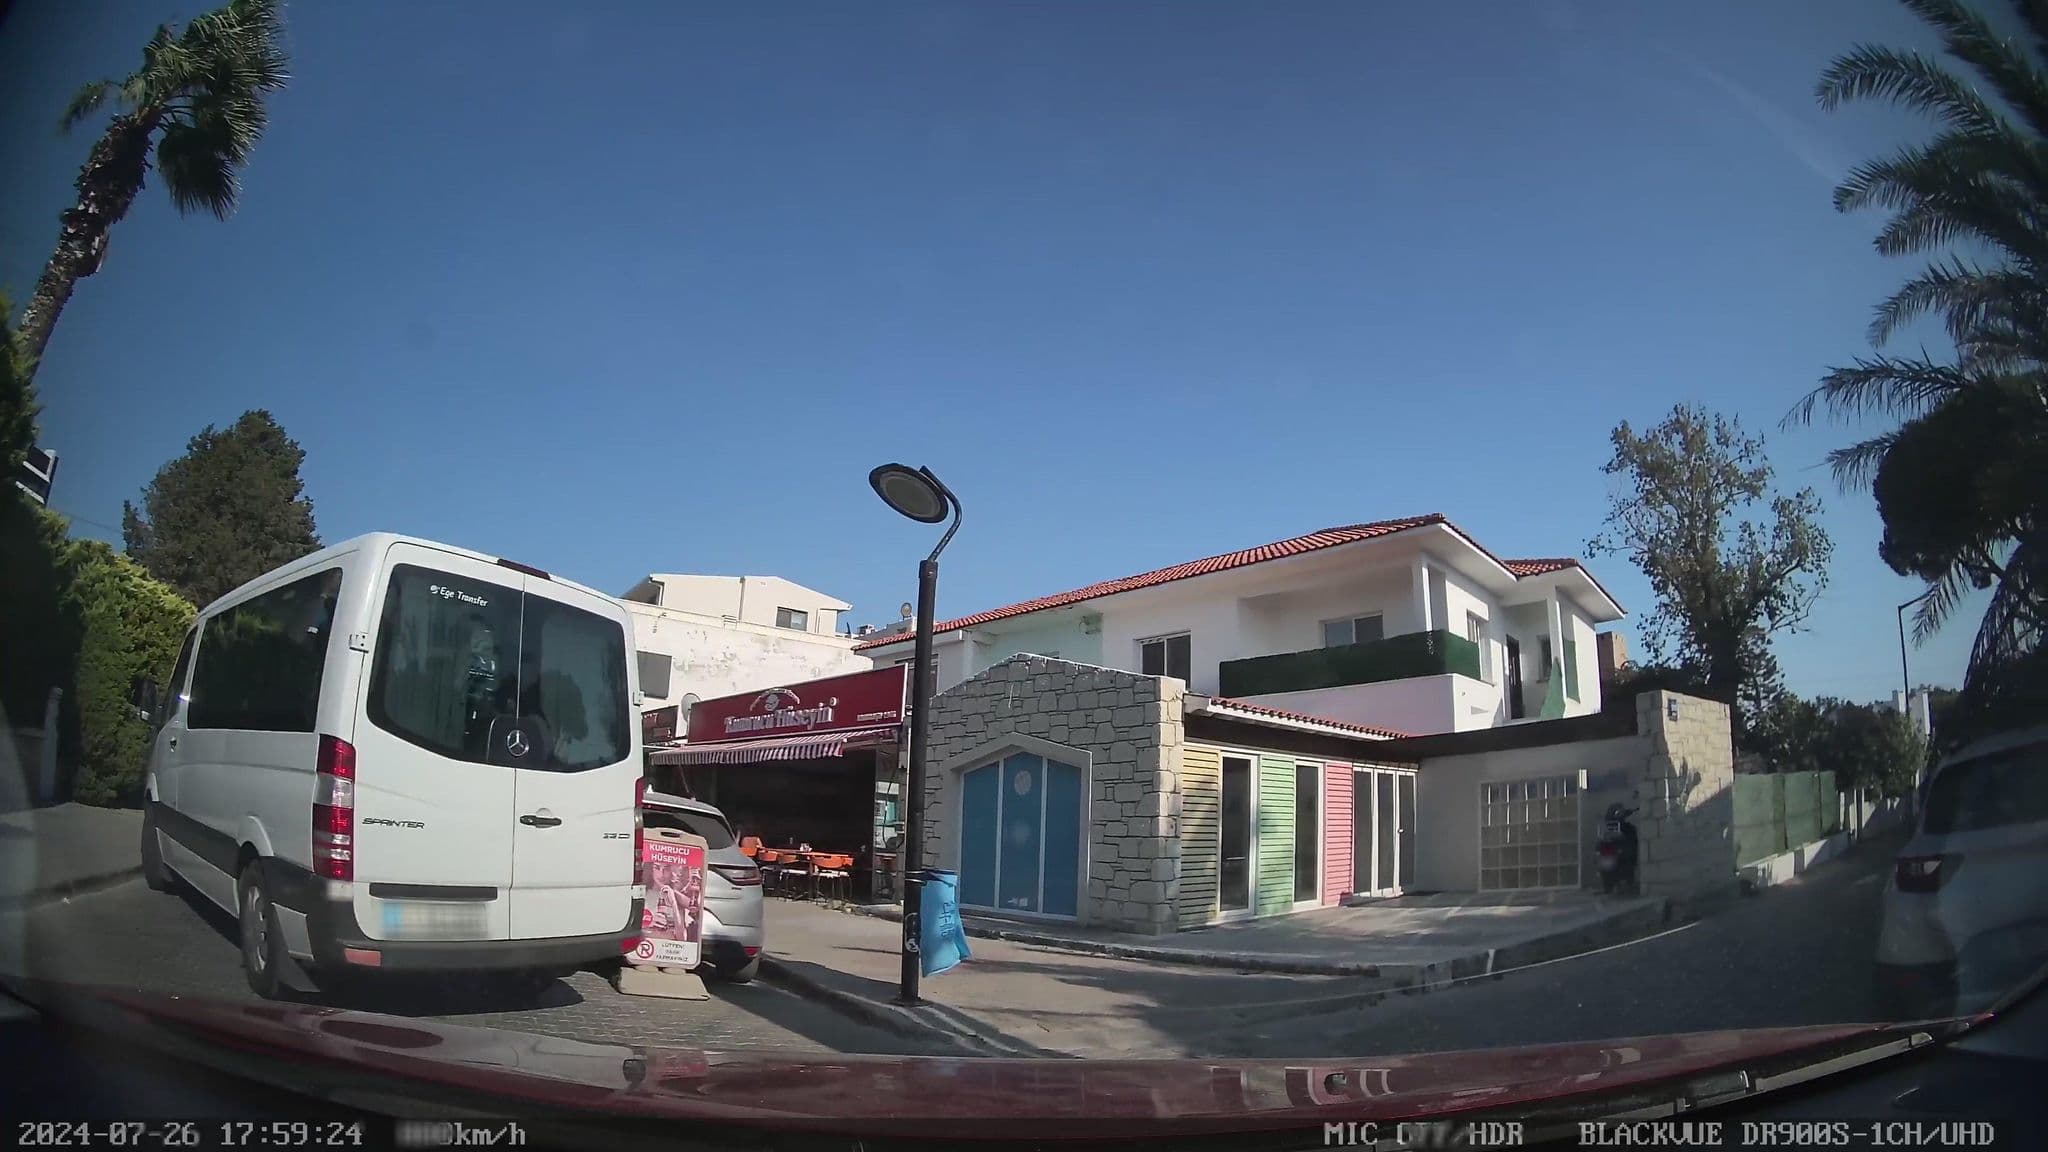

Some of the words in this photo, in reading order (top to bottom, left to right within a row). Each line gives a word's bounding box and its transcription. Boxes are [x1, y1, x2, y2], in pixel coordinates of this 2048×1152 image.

[440, 586, 455, 599] Ege
[457, 591, 489, 607] Transfer
[775, 702, 833, 731] Hüseyin
[362, 817, 425, 829] SPRINTER
[649, 843, 690, 856] KUMRUCU
[651, 852, 687, 865] HÜSEYİN
